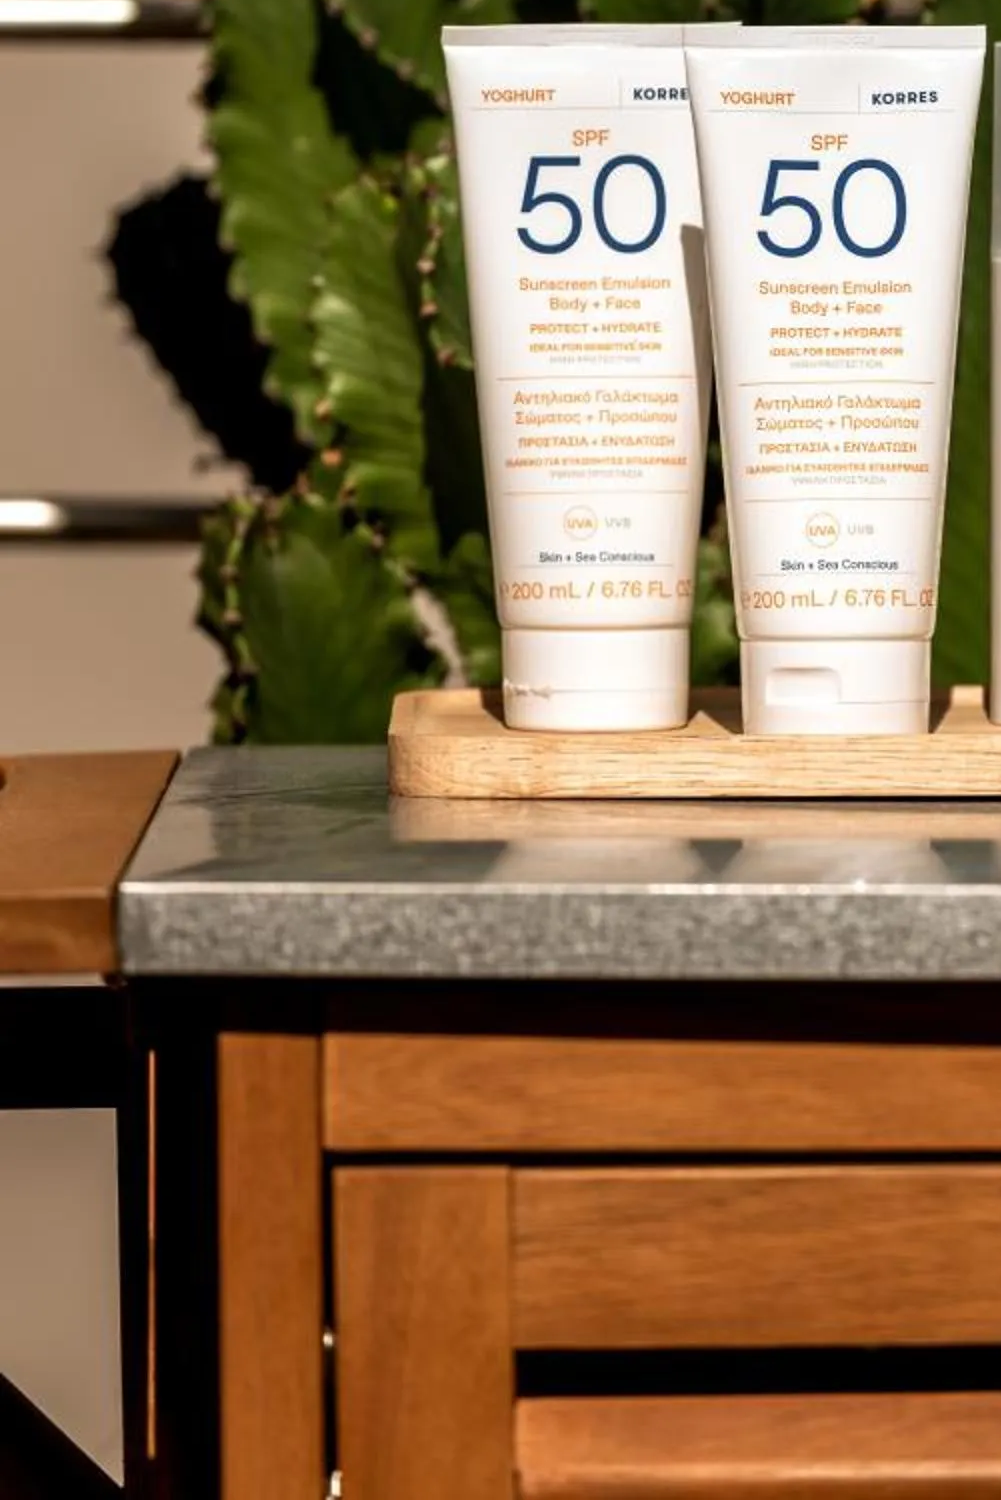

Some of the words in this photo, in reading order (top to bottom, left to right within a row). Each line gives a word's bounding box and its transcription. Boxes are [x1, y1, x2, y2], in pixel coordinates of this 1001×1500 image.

[481, 89, 555, 102] YOGHURT
[633, 87, 689, 100] KORRE
[720, 91, 795, 105] YOGHURT
[871, 91, 938, 105] KORRES
[572, 129, 610, 147] SPF
[811, 134, 848, 151] SPF
[517, 154, 667, 254] 50
[757, 158, 907, 258] 50
[519, 277, 597, 291] Sunscreen
[602, 276, 671, 290] Emulsion
[759, 281, 838, 295] Sunscreen
[842, 280, 912, 294] Emulsion
[549, 297, 587, 312] Body
[605, 297, 641, 310] Face
[790, 300, 828, 316] Body
[847, 301, 883, 314] Face
[529, 323, 588, 334] PROTECT
[601, 322, 662, 334] HYDRATE
[770, 327, 830, 338] PROTECT
[843, 327, 903, 338] HYDRATE
[770, 348, 800, 357] IDEAL
[567, 518, 593, 529] UVA
[809, 526, 836, 537] UVA
[539, 551, 562, 563] Skin
[575, 551, 597, 562] Sea
[599, 550, 655, 562] Conscious
[780, 559, 804, 571] Skin
[817, 559, 839, 571] Sea
[841, 558, 899, 570] Conscious
[511, 582, 543, 599] 200
[550, 582, 580, 599] mL
[602, 580, 641, 598] 6.76
[753, 591, 785, 609] 200
[791, 589, 825, 608] mL
[829, 589, 838, 607] /
[845, 589, 885, 607] 6.76
